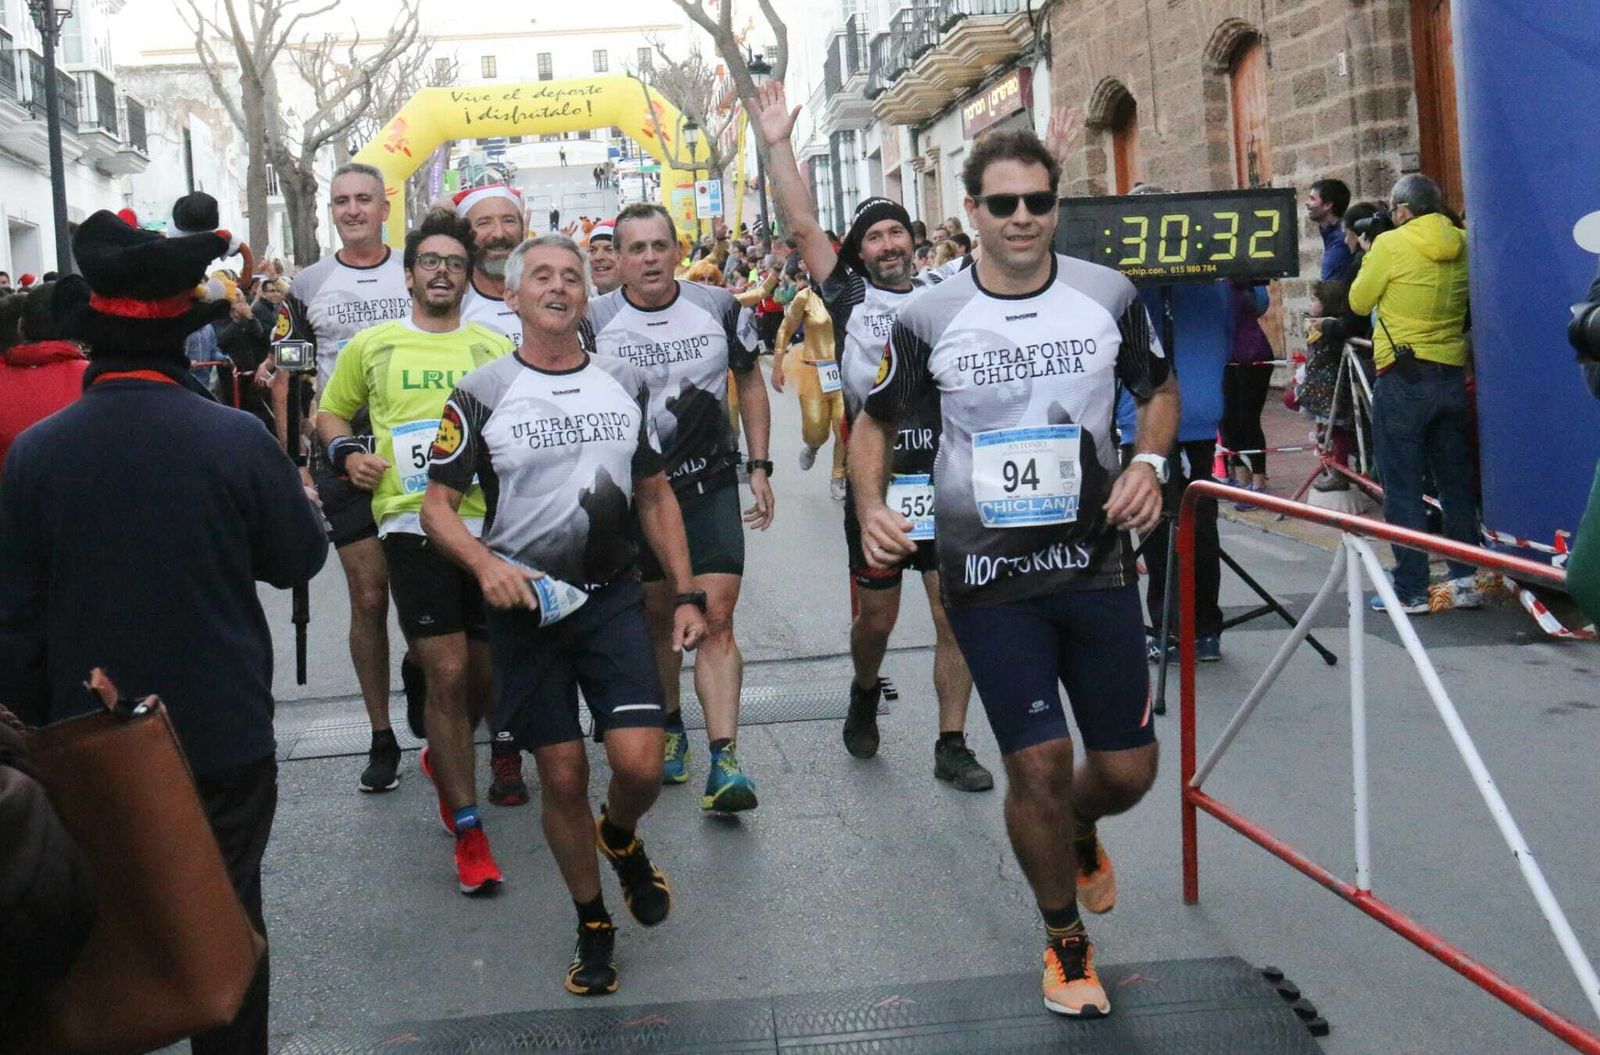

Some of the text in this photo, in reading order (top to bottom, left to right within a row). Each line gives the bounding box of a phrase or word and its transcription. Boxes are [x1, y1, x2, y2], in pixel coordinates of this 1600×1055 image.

[451, 84, 603, 103] Vive el deporte
[338, 308, 406, 324] CHICLANA
[618, 335, 709, 358] ULTRAFONDO
[629, 348, 703, 367] CHICLANA
[957, 338, 1097, 372] ULTRAFONDO
[973, 356, 1085, 386] CHICLANA
[512, 411, 631, 439] ULTRAFONDO
[529, 426, 626, 450] CHICLANA
[1008, 440, 1048, 450] ANTONIO
[1003, 458, 1040, 493] 94
[901, 494, 934, 518] 552
[980, 494, 1079, 524] CHICLANA
